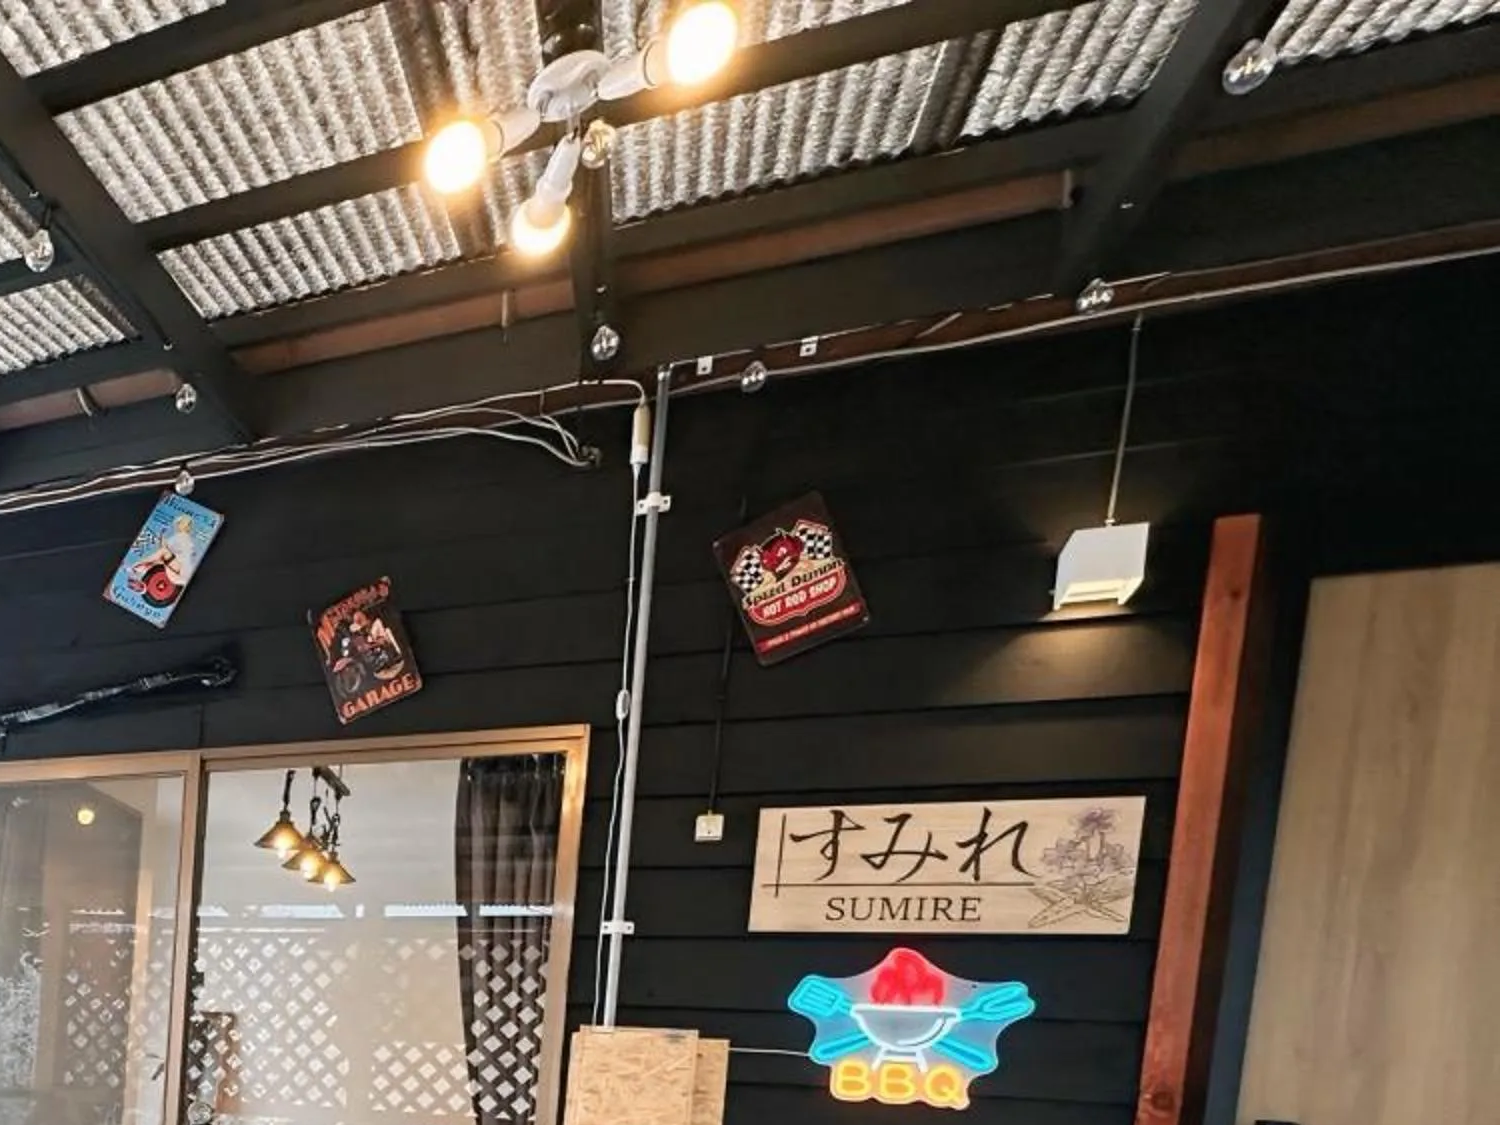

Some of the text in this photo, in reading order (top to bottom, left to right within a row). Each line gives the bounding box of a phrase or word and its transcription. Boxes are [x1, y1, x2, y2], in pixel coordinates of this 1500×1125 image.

[342, 672, 416, 718] GARAGE
[789, 807, 1042, 883] すみれ
[824, 895, 983, 922] SUMIRE
[834, 1059, 966, 1108] BBQ
